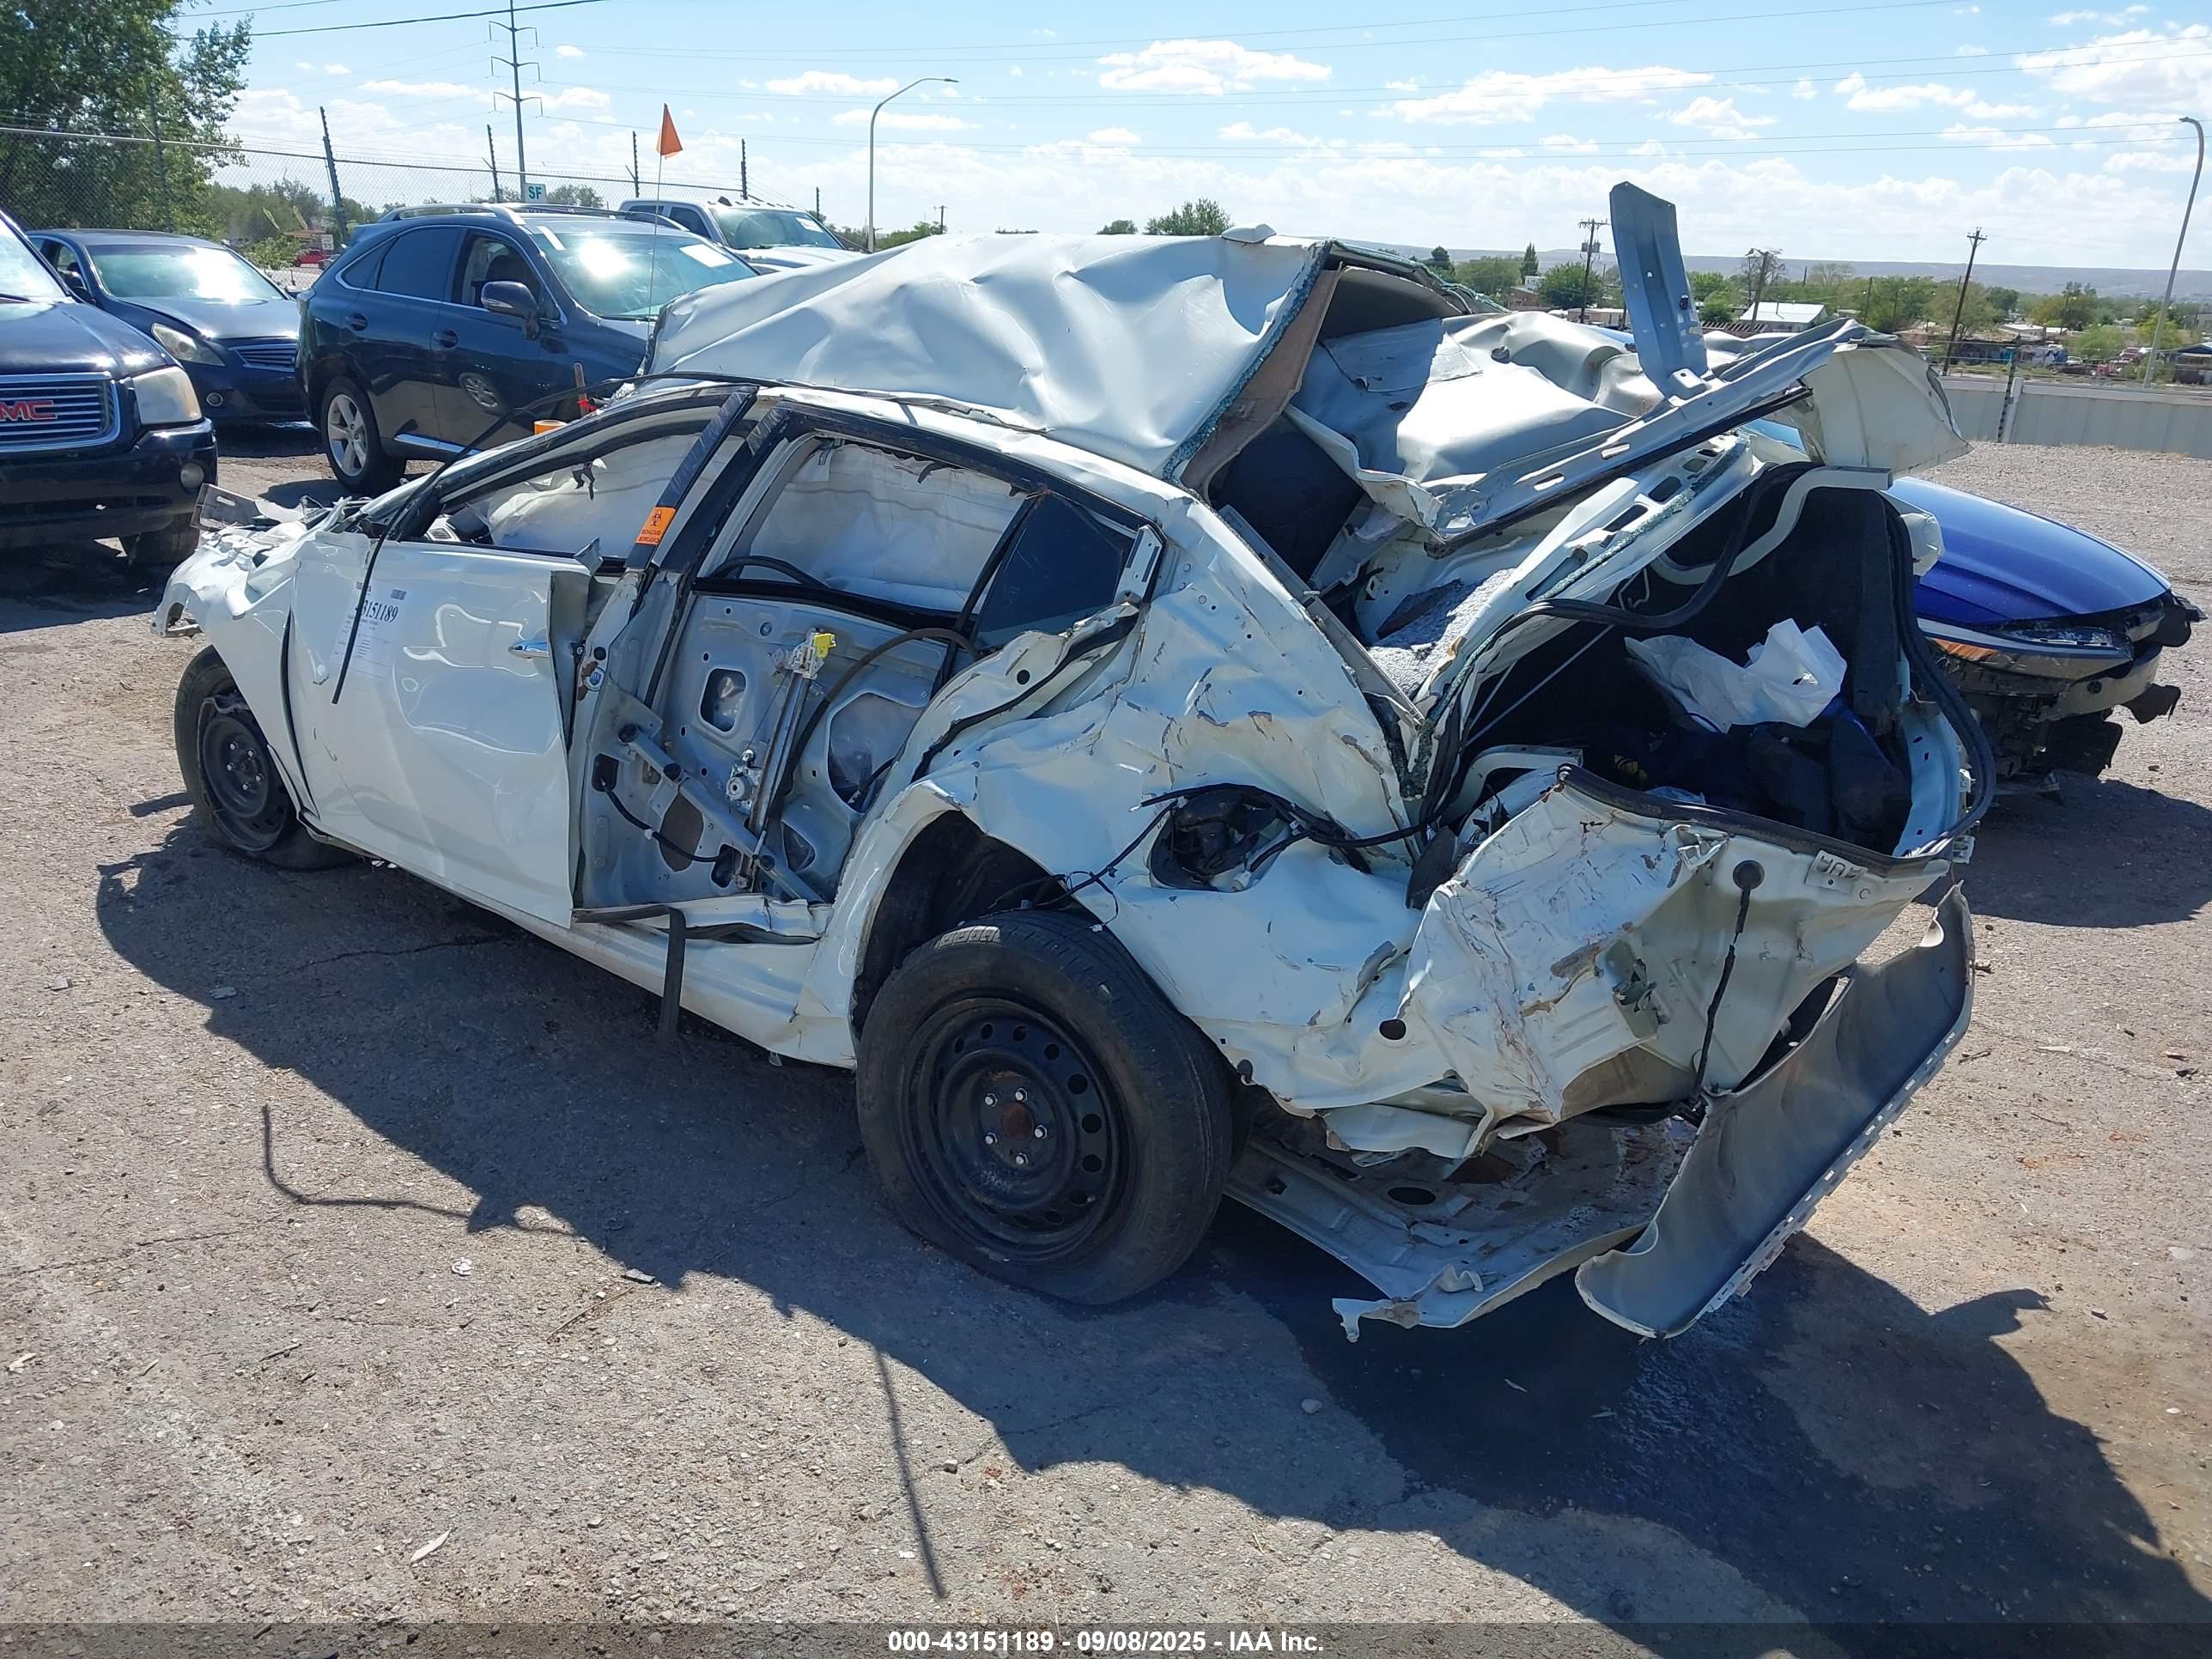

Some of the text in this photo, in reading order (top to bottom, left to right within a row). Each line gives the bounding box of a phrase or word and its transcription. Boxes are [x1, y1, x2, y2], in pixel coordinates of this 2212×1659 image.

[528, 185, 542, 199] SF
[0, 399, 58, 421] MC
[355, 599, 398, 623] 3151189
